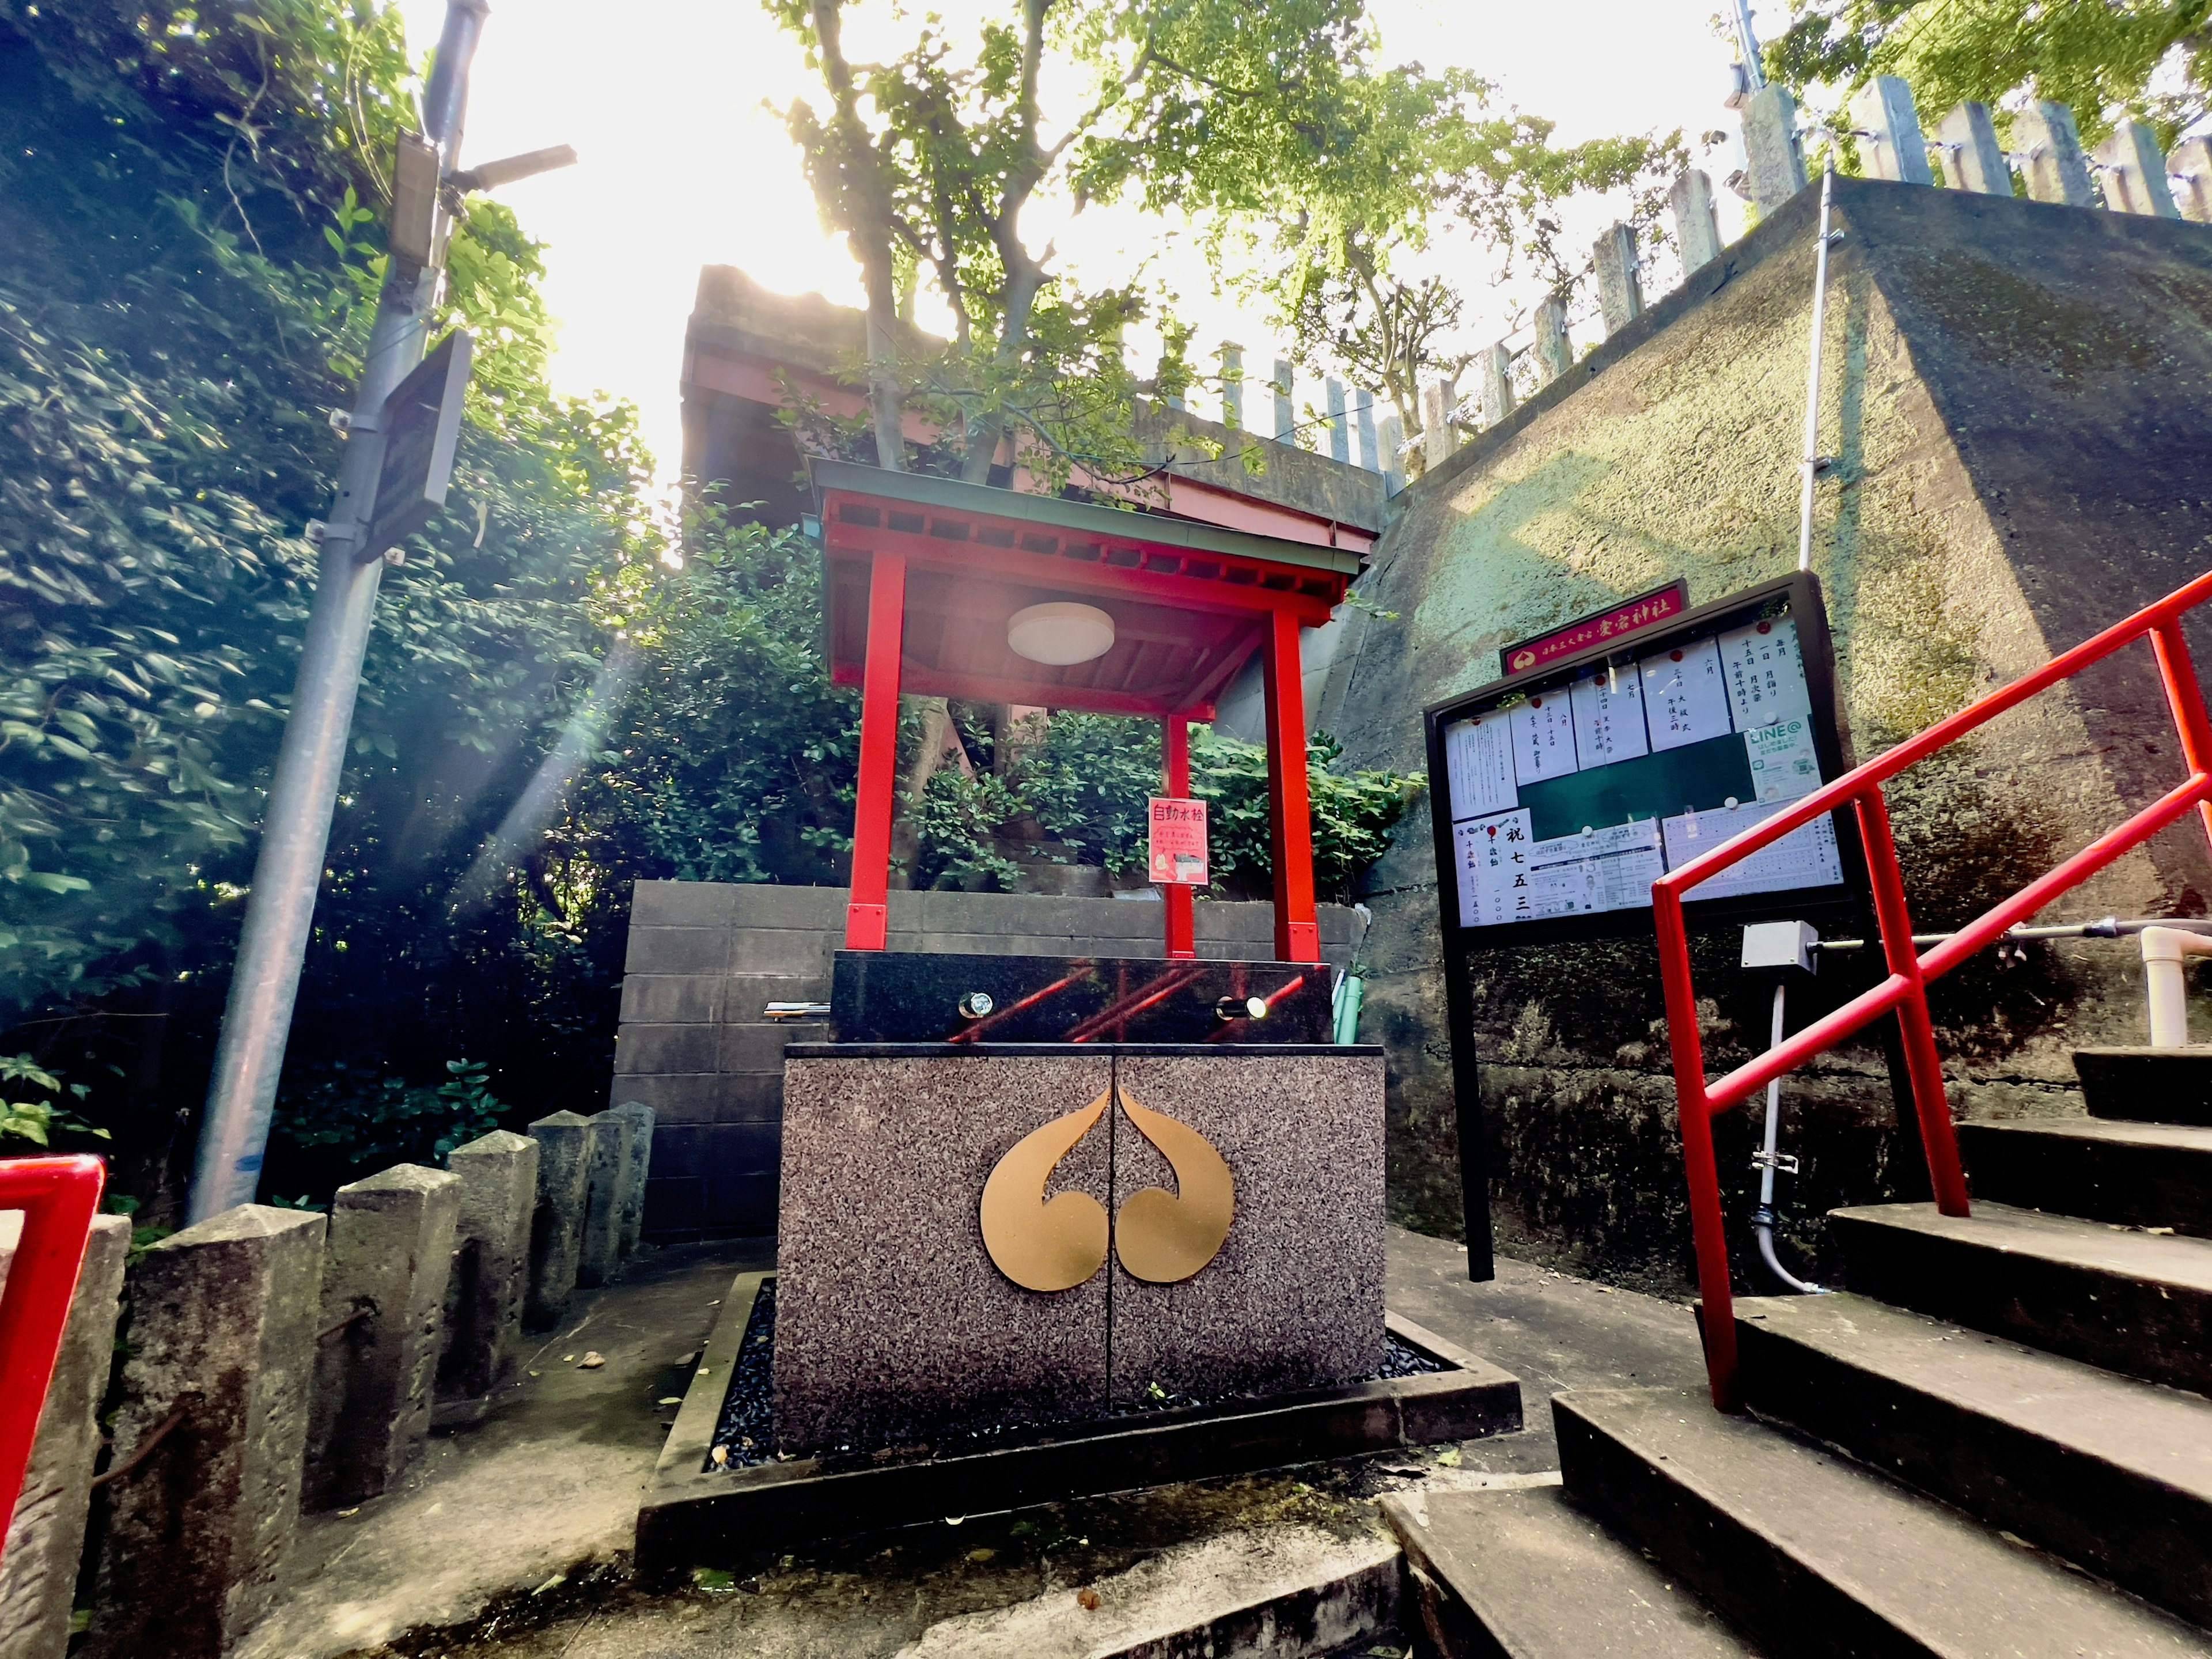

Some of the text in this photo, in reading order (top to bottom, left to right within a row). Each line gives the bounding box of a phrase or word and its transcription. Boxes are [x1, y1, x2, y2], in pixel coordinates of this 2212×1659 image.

[1597, 599, 1672, 636] 愛宕神社
[1760, 645, 1770, 660] 一日
[1776, 639, 1786, 657] 毎月
[1705, 658, 1714, 675] 六月
[1742, 639, 1762, 702] 十五日 月次祭
[1674, 669, 1683, 687] 三十日
[1733, 662, 1749, 714] 午前十時より
[1599, 686, 1608, 710] 二十四日
[1627, 684, 1635, 699] 七月
[1560, 713, 1567, 726] 八月
[1668, 698, 1679, 730] 午後三時
[1751, 721, 1802, 744] LINE@
[1154, 804, 1204, 821] 自動水栓
[1506, 827, 1531, 911] 祝七五三
